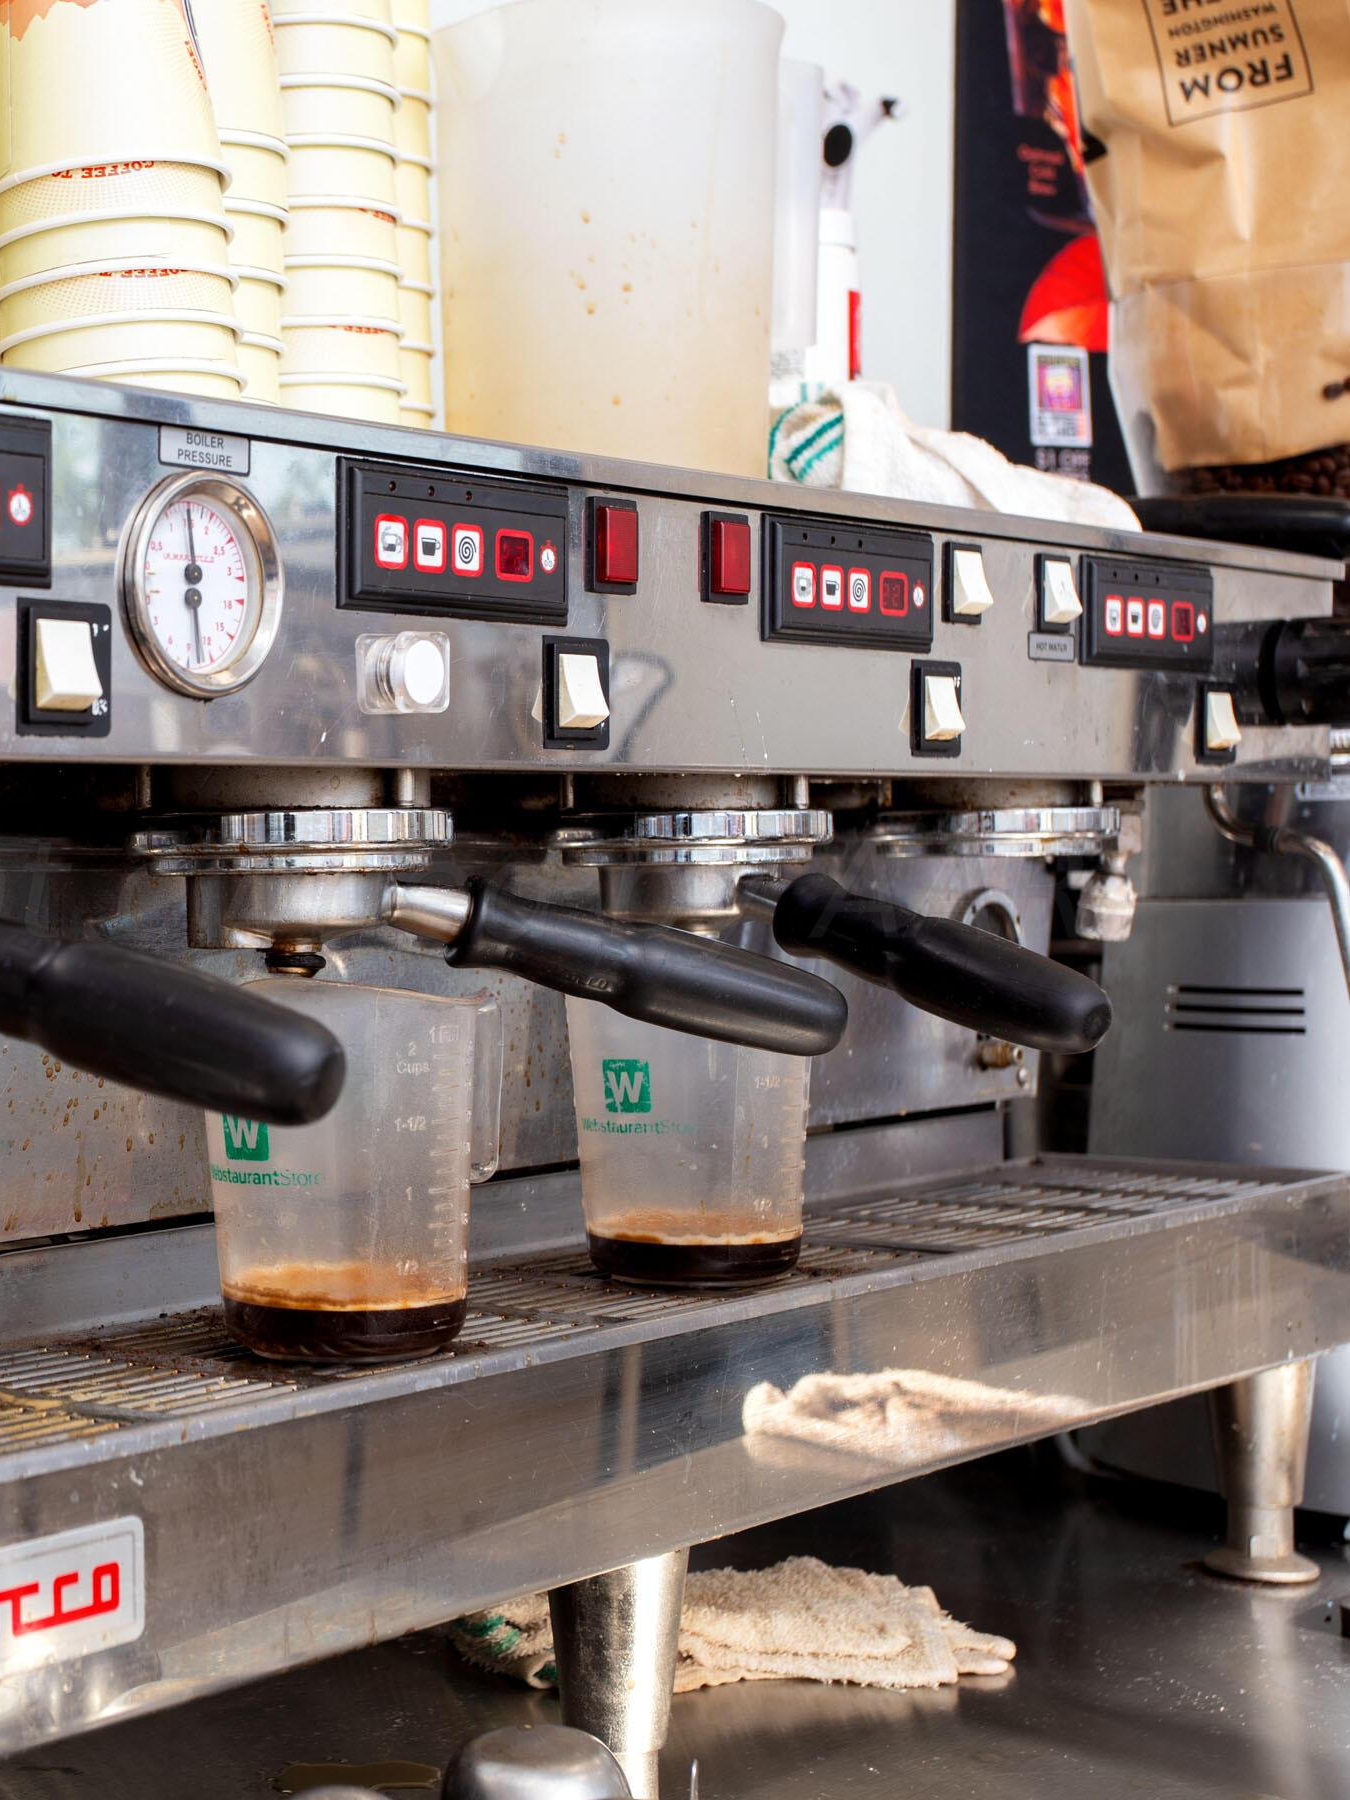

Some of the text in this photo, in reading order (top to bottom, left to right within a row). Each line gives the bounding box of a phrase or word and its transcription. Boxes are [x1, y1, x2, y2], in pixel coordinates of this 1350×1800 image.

[1169, 3, 1277, 40] WASHINGTON
[1176, 23, 1285, 67] SUMNER
[1180, 53, 1295, 103] FROM
[177, 449, 233, 468] PRESSURE
[186, 432, 224, 449] BOILER
[606, 1071, 644, 1104] W
[223, 1112, 259, 1150] W
